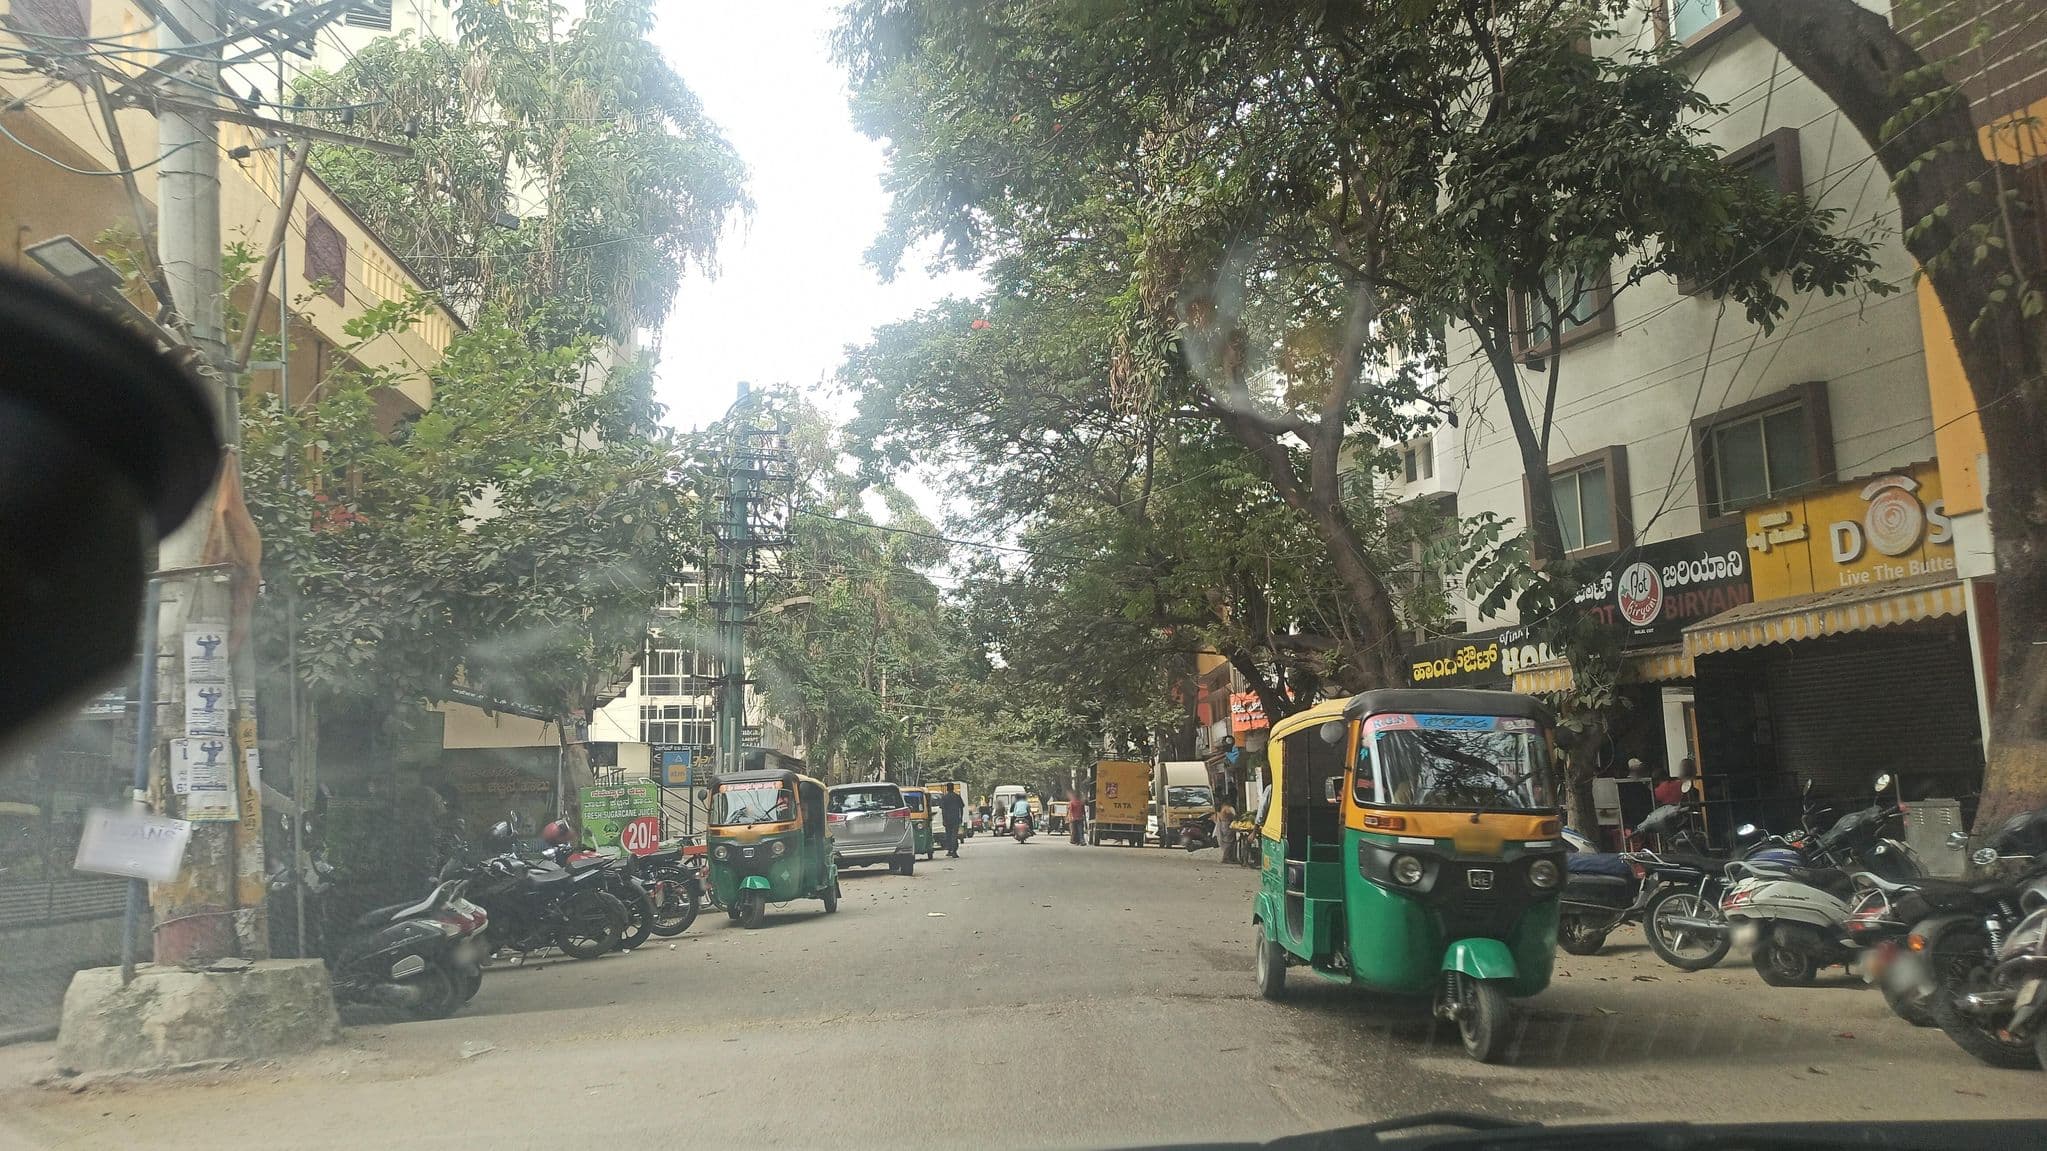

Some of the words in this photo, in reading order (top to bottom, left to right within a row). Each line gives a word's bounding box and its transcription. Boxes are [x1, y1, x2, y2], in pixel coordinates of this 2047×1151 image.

[1662, 550, 1743, 588] ಬಿರಿಯಾನಿ
[1839, 569, 1870, 587] Live
[1873, 562, 1905, 581] The
[1664, 583, 1750, 620] BIRYANI
[584, 812, 603, 820] FRESH
[603, 809, 638, 820] SUGARCANE
[638, 807, 655, 816] JUICE
[628, 821, 658, 850] 20/-
